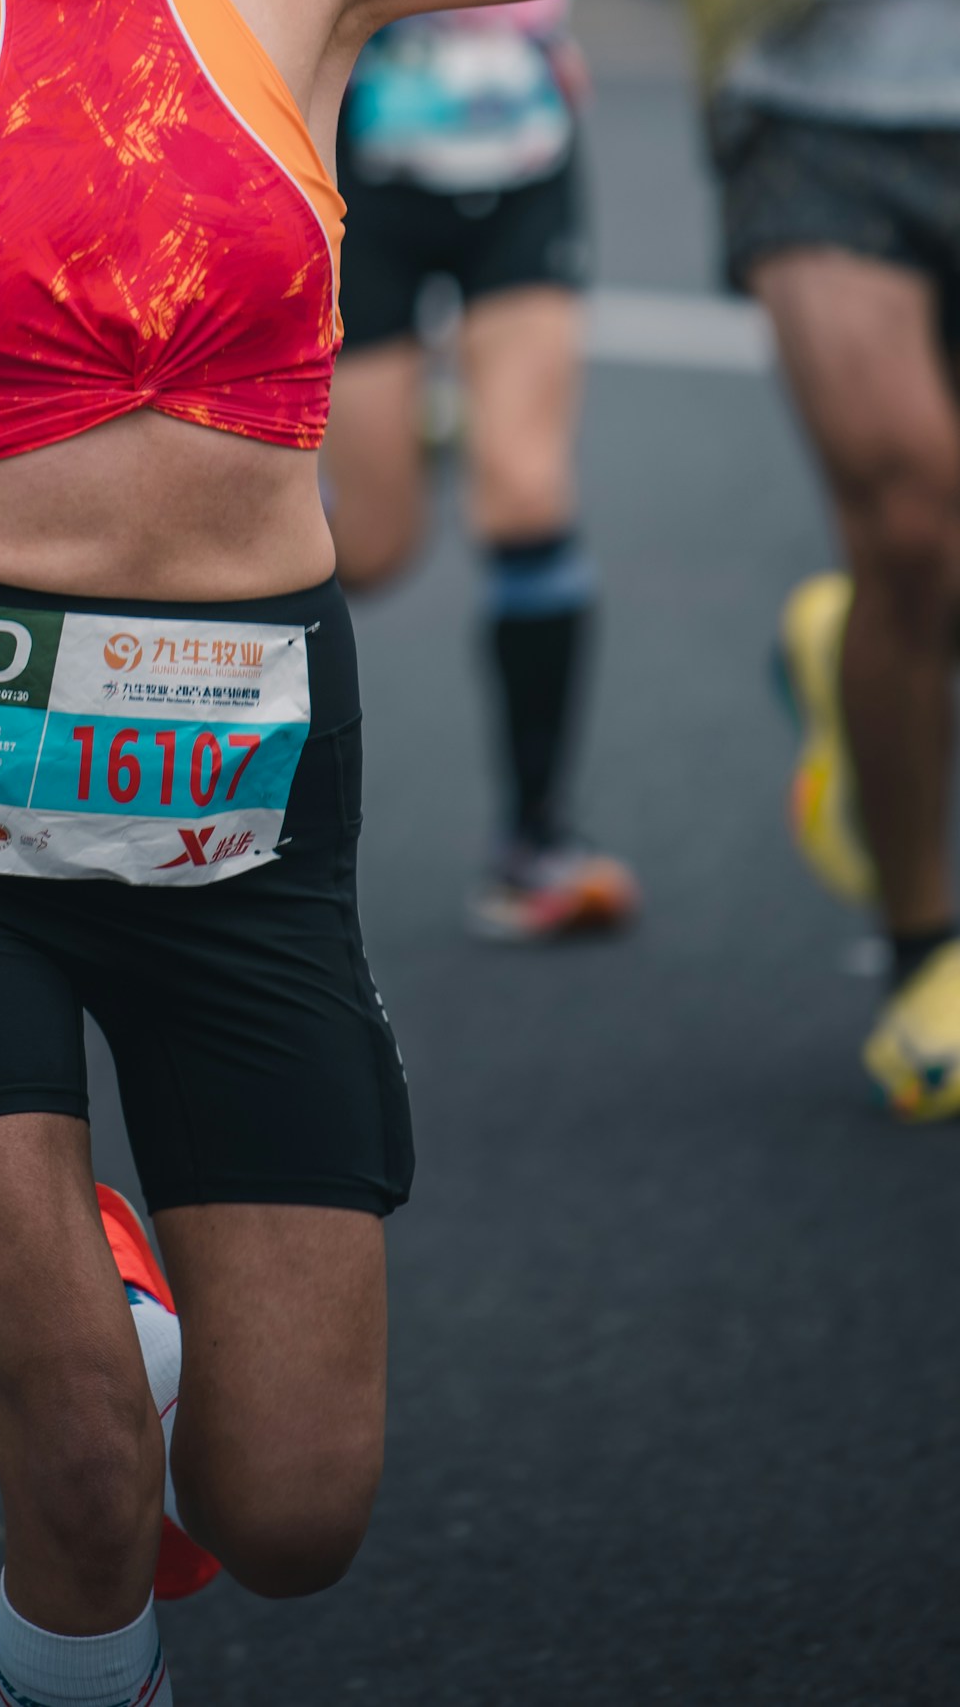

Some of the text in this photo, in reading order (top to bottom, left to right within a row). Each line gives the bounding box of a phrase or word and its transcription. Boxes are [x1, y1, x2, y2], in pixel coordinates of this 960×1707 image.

[152, 637, 264, 667] 九牛牧业
[150, 664, 263, 679] JIUNIU ANIMAL HUSBANDRY
[72, 725, 262, 807] 16107
